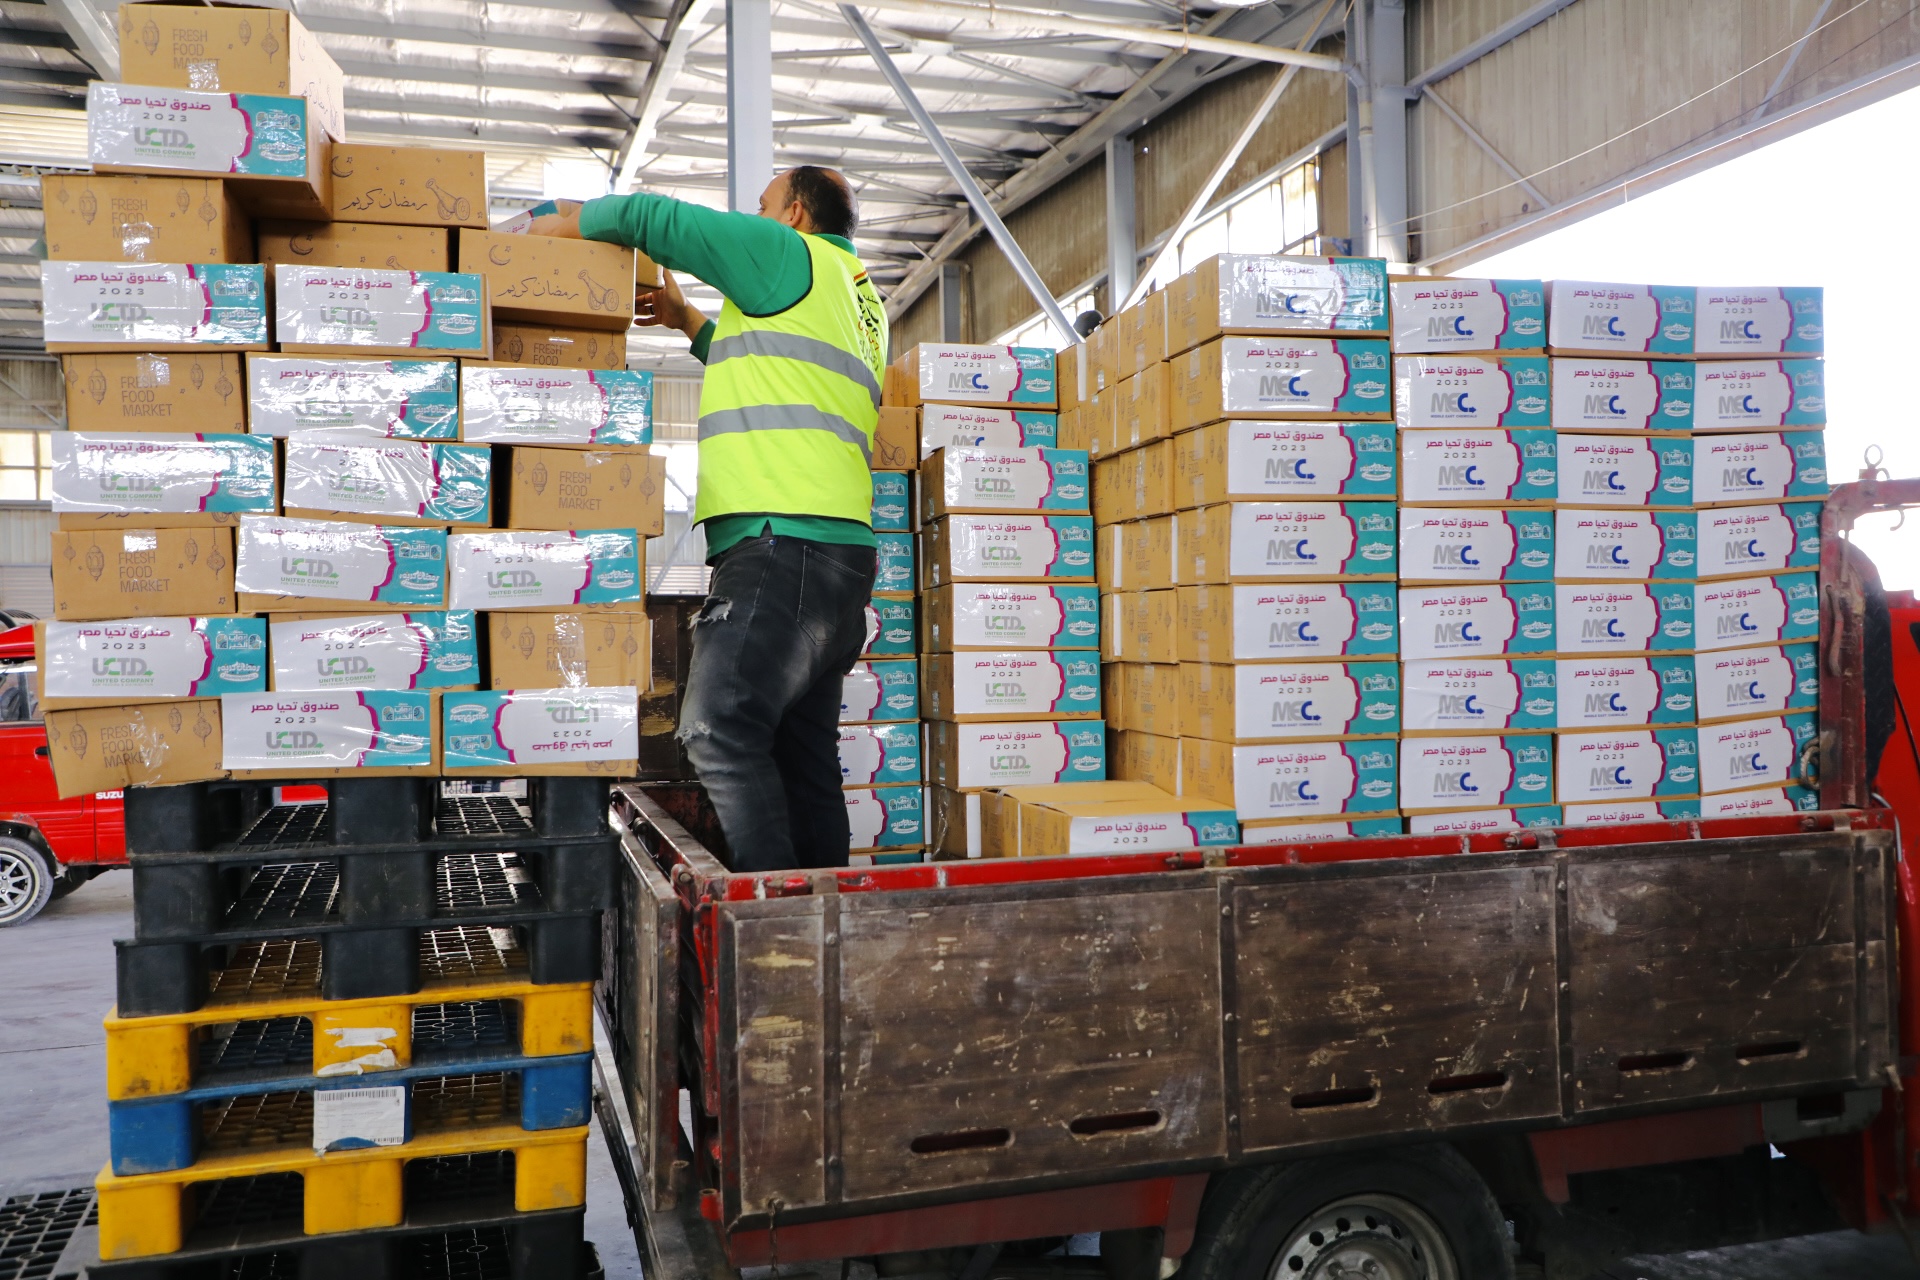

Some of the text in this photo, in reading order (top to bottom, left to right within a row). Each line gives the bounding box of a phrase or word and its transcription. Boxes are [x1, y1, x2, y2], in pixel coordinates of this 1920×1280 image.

[173, 29, 207, 42] FRESH
[174, 43, 204, 56] FOOD
[145, 97, 167, 108] تحيا
[170, 99, 211, 111] صندوق
[143, 112, 187, 122] 2023
[134, 127, 195, 149] UCTD
[112, 198, 148, 210] FRESH
[341, 188, 428, 210] رمضان كريم
[112, 212, 144, 224] FOOD
[74, 273, 168, 284] صندوق تحيا مصر
[305, 278, 327, 286] مصر
[331, 278, 351, 288] تحيا
[100, 288, 144, 296] 2023
[496, 277, 579, 300] رمضان كريم
[1451, 290, 1479, 299] صندوق
[329, 292, 370, 300] 2023
[1434, 290, 1448, 300] تحيا
[91, 303, 154, 321] UCTD
[320, 306, 378, 326] UCTD
[1427, 316, 1474, 336] MEC
[533, 343, 562, 355] FRESH
[533, 355, 558, 366] FOOD
[1592, 369, 1606, 378] تحيا
[1608, 370, 1635, 379] صندوق
[514, 378, 533, 388] تحيا
[536, 378, 572, 389] صندوق
[948, 373, 989, 390] MEC
[122, 390, 155, 402] FOOD
[123, 404, 172, 416] MARKET
[1584, 395, 1626, 414] MEC
[1274, 431, 1290, 440] تحيا
[1294, 431, 1324, 441] صندوق
[1265, 458, 1316, 479] MEC
[560, 471, 591, 484] FRESH
[560, 484, 588, 496] FOOD
[559, 497, 602, 510] MARKET
[1256, 512, 1326, 522] صندوق تحيا مصر
[1266, 539, 1316, 560] MEC
[119, 551, 156, 564] FRESH
[120, 566, 152, 578] FOOD
[281, 557, 339, 578] UCTD
[487, 570, 542, 588] UCTD
[120, 579, 170, 592] MARKET
[992, 593, 1007, 601] تحيا
[1009, 593, 1037, 602] صندوق
[1590, 594, 1604, 602] تحيا
[1606, 593, 1633, 602] صندوق
[985, 616, 1026, 630] UCTD
[1582, 619, 1625, 638] MEC
[78, 628, 171, 640] صندوق تحيا مصر
[92, 658, 154, 676] UCTD
[317, 656, 375, 676] UCTD
[1716, 656, 1770, 669] صندوق تحيا مصر
[1280, 674, 1296, 684] تحيا
[1300, 674, 1329, 684] صندوق
[1448, 669, 1462, 678] تحيا
[1465, 669, 1494, 678] صندوق
[1731, 669, 1757, 677] 2023
[1726, 681, 1766, 700] MEC
[251, 702, 340, 713] صندوق تحيا مصر
[1438, 694, 1484, 715] MEC
[1272, 700, 1321, 722] MEC
[266, 731, 324, 749] UCTD
[980, 732, 1042, 742] صندوق تحيا مصر
[102, 738, 133, 754] FOOD
[532, 740, 613, 752] صندوق تحيا مصر
[104, 751, 146, 768] MARKE
[990, 755, 1031, 770] UCTD
[1116, 823, 1132, 833] تحيا
[1135, 823, 1167, 832] صندوق
